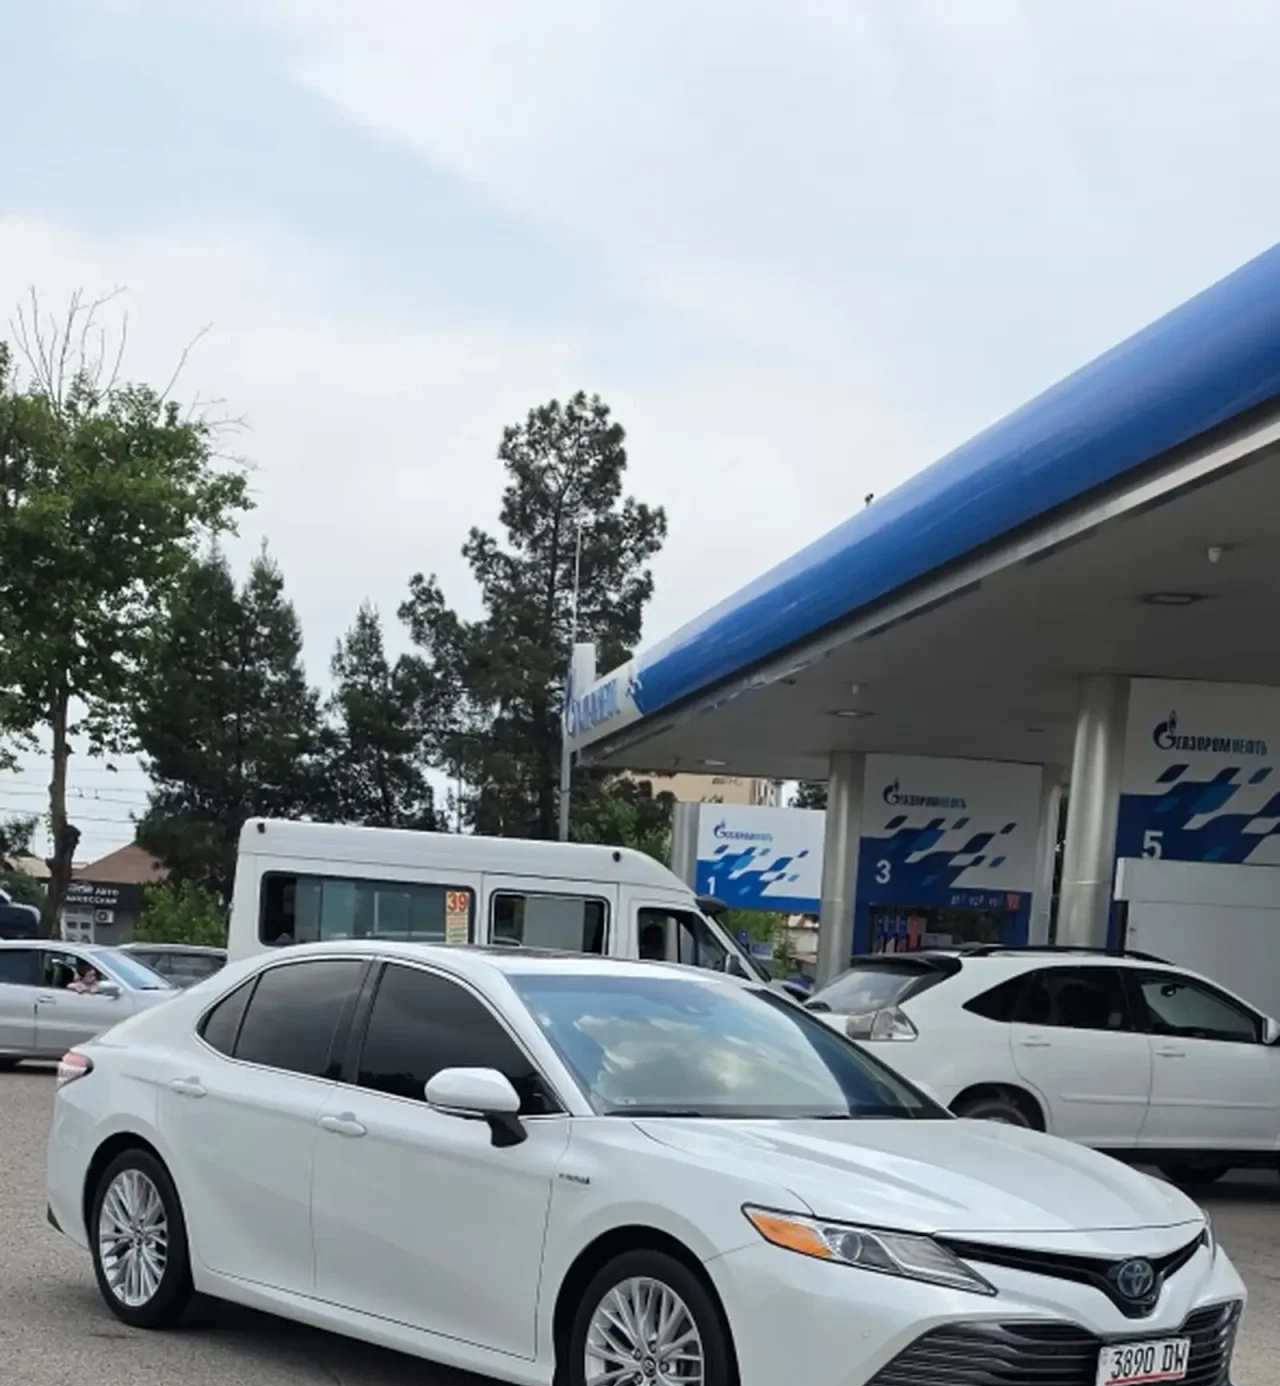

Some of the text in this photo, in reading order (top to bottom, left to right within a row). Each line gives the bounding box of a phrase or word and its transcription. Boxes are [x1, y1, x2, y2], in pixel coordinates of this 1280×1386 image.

[1141, 830, 1164, 859] 5
[875, 859, 891, 885] 3
[707, 876, 716, 895] 1
[447, 892, 468, 912] 39
[1111, 1347, 1155, 1379] 3890
